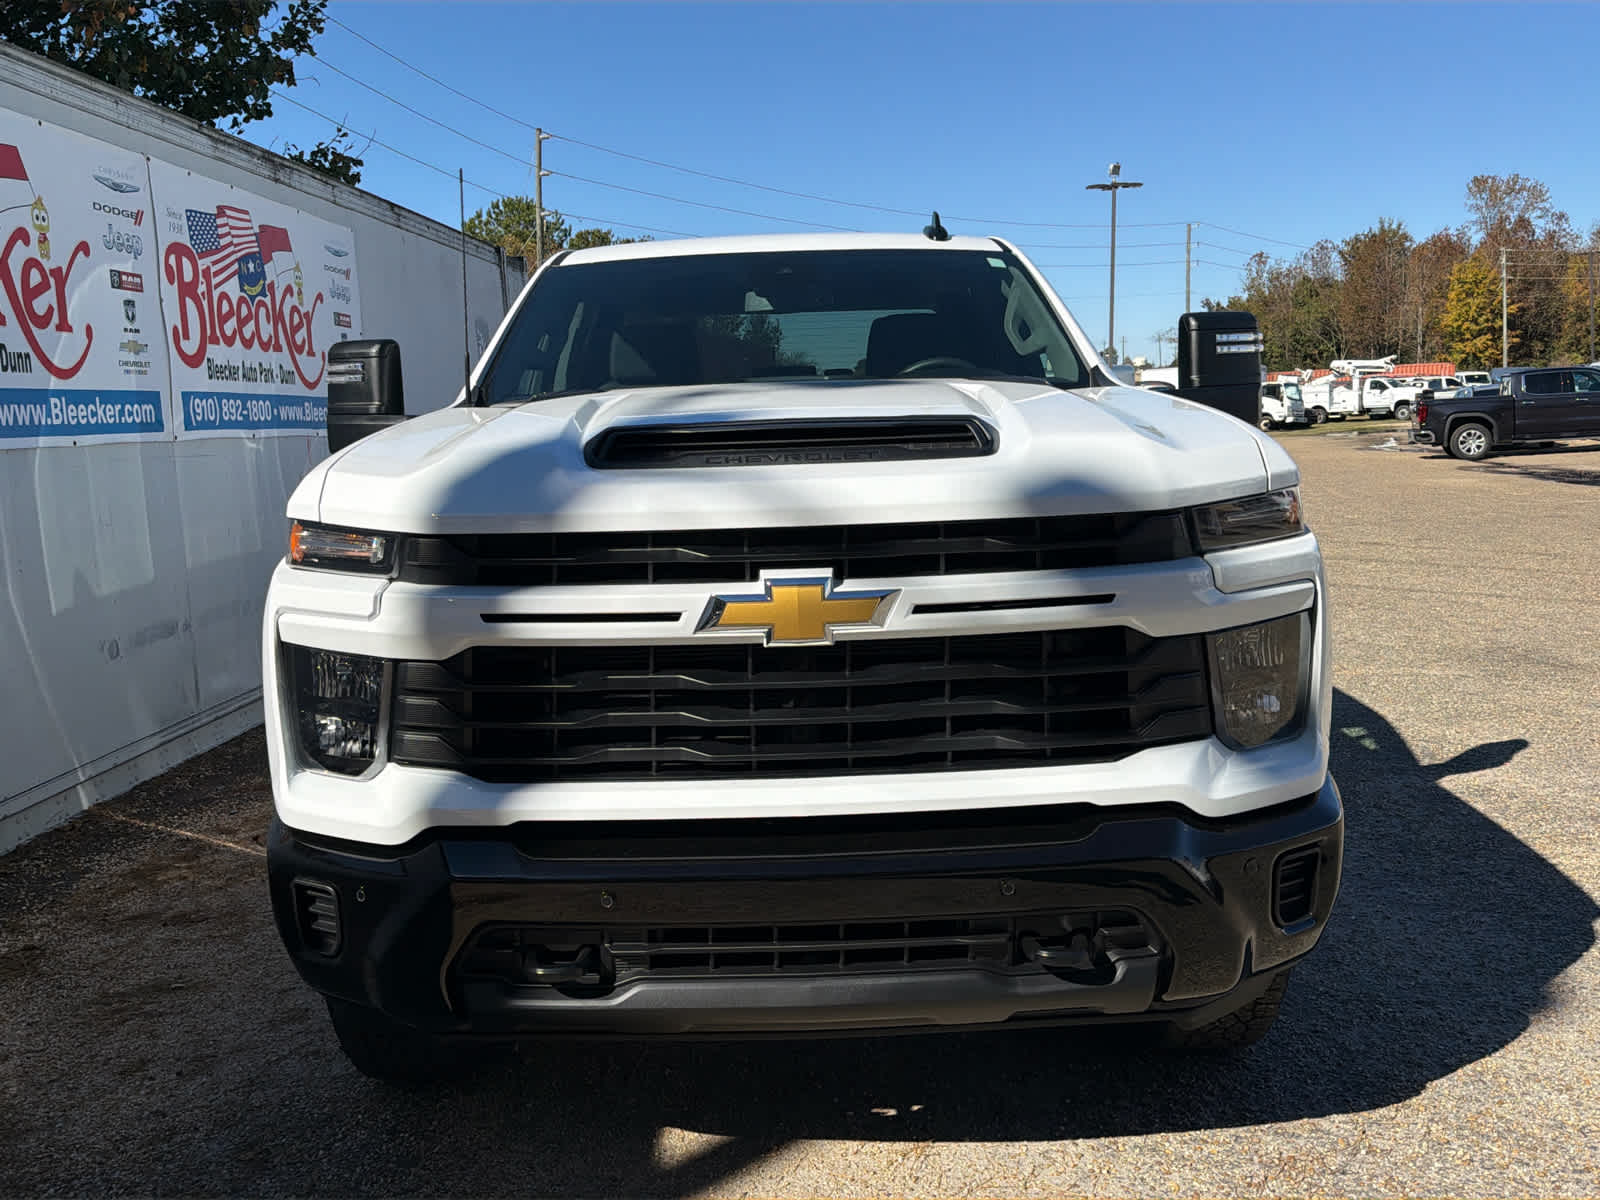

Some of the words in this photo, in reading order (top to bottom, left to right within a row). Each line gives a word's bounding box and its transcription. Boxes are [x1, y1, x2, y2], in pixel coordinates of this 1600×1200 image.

[92, 201, 138, 220] DODGE
[102, 223, 143, 260] Jeep
[164, 241, 326, 390] Bleecker
[0, 343, 32, 374] Dunn
[118, 359, 152, 369] CHEVROLET
[207, 357, 240, 381] Bleecker
[242, 359, 258, 381] Auto
[259, 361, 274, 383] Park
[279, 365, 296, 385] Dunn
[0, 396, 156, 427] www.Bleecker.com
[190, 396, 220, 426] (910)
[222, 399, 272, 422] 892-1800
[704, 450, 877, 465] CHEVROLET
